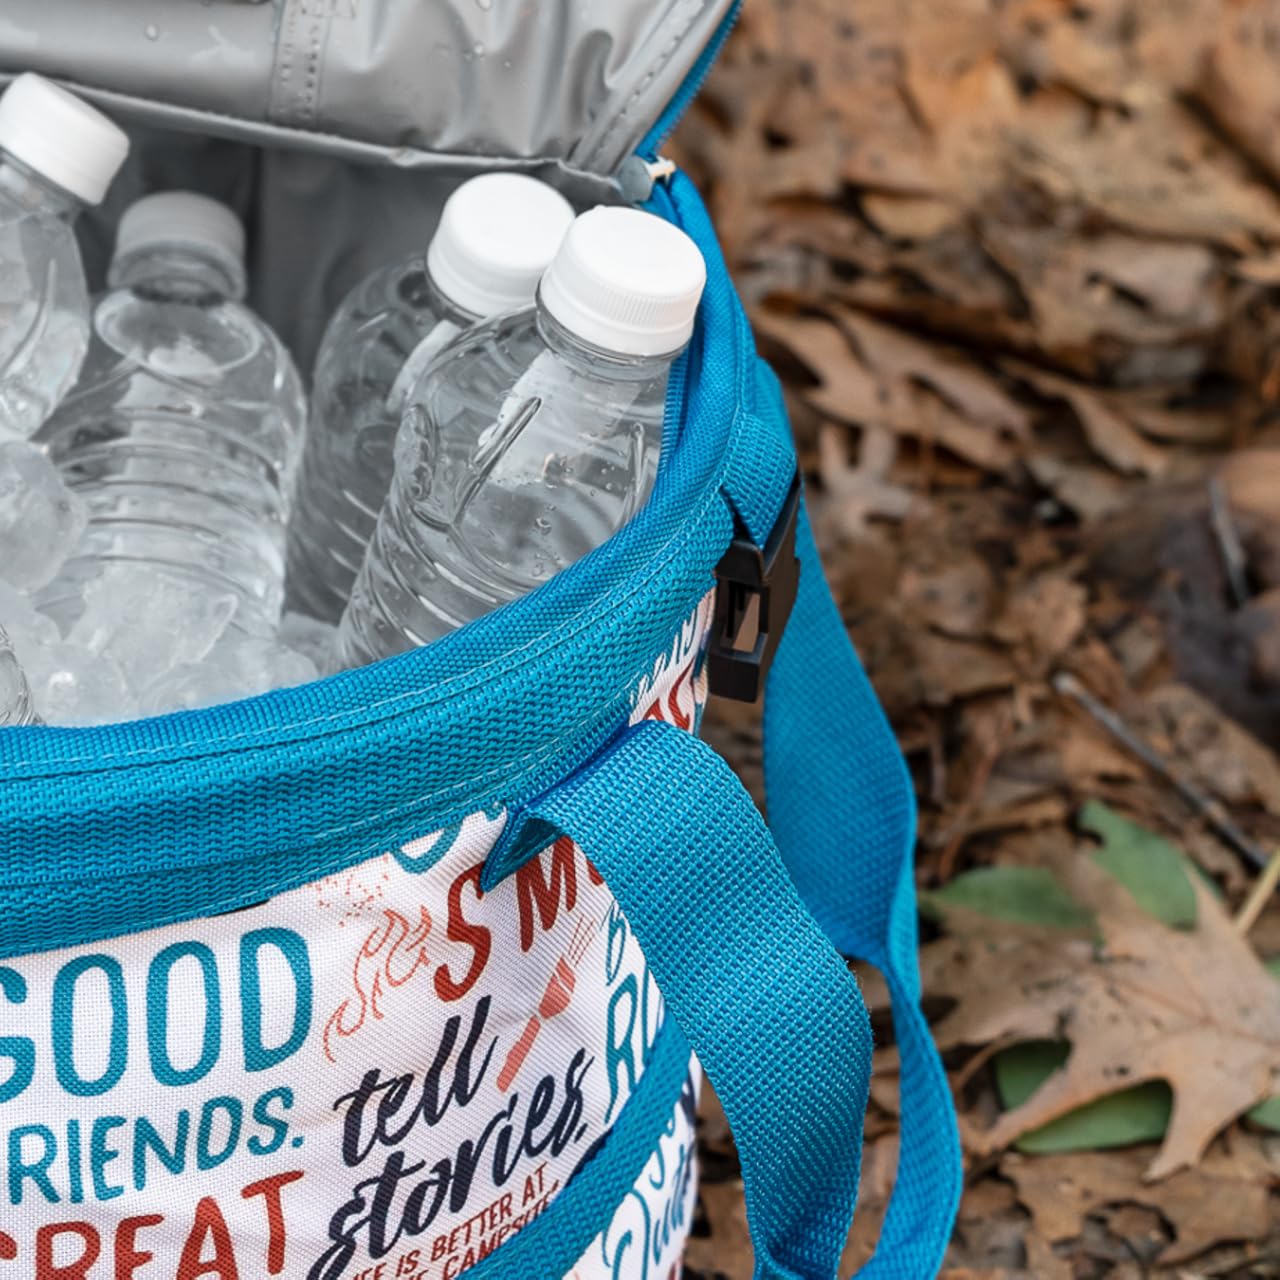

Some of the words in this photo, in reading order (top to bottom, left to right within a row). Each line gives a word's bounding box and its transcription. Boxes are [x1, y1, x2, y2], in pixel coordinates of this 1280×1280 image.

[303, 1048, 595, 1280] stories.
[332, 994, 498, 1167] tell
[395, 1249, 421, 1278] IS
[430, 1192, 513, 1263] BETTER
[521, 1161, 549, 1207] AT
